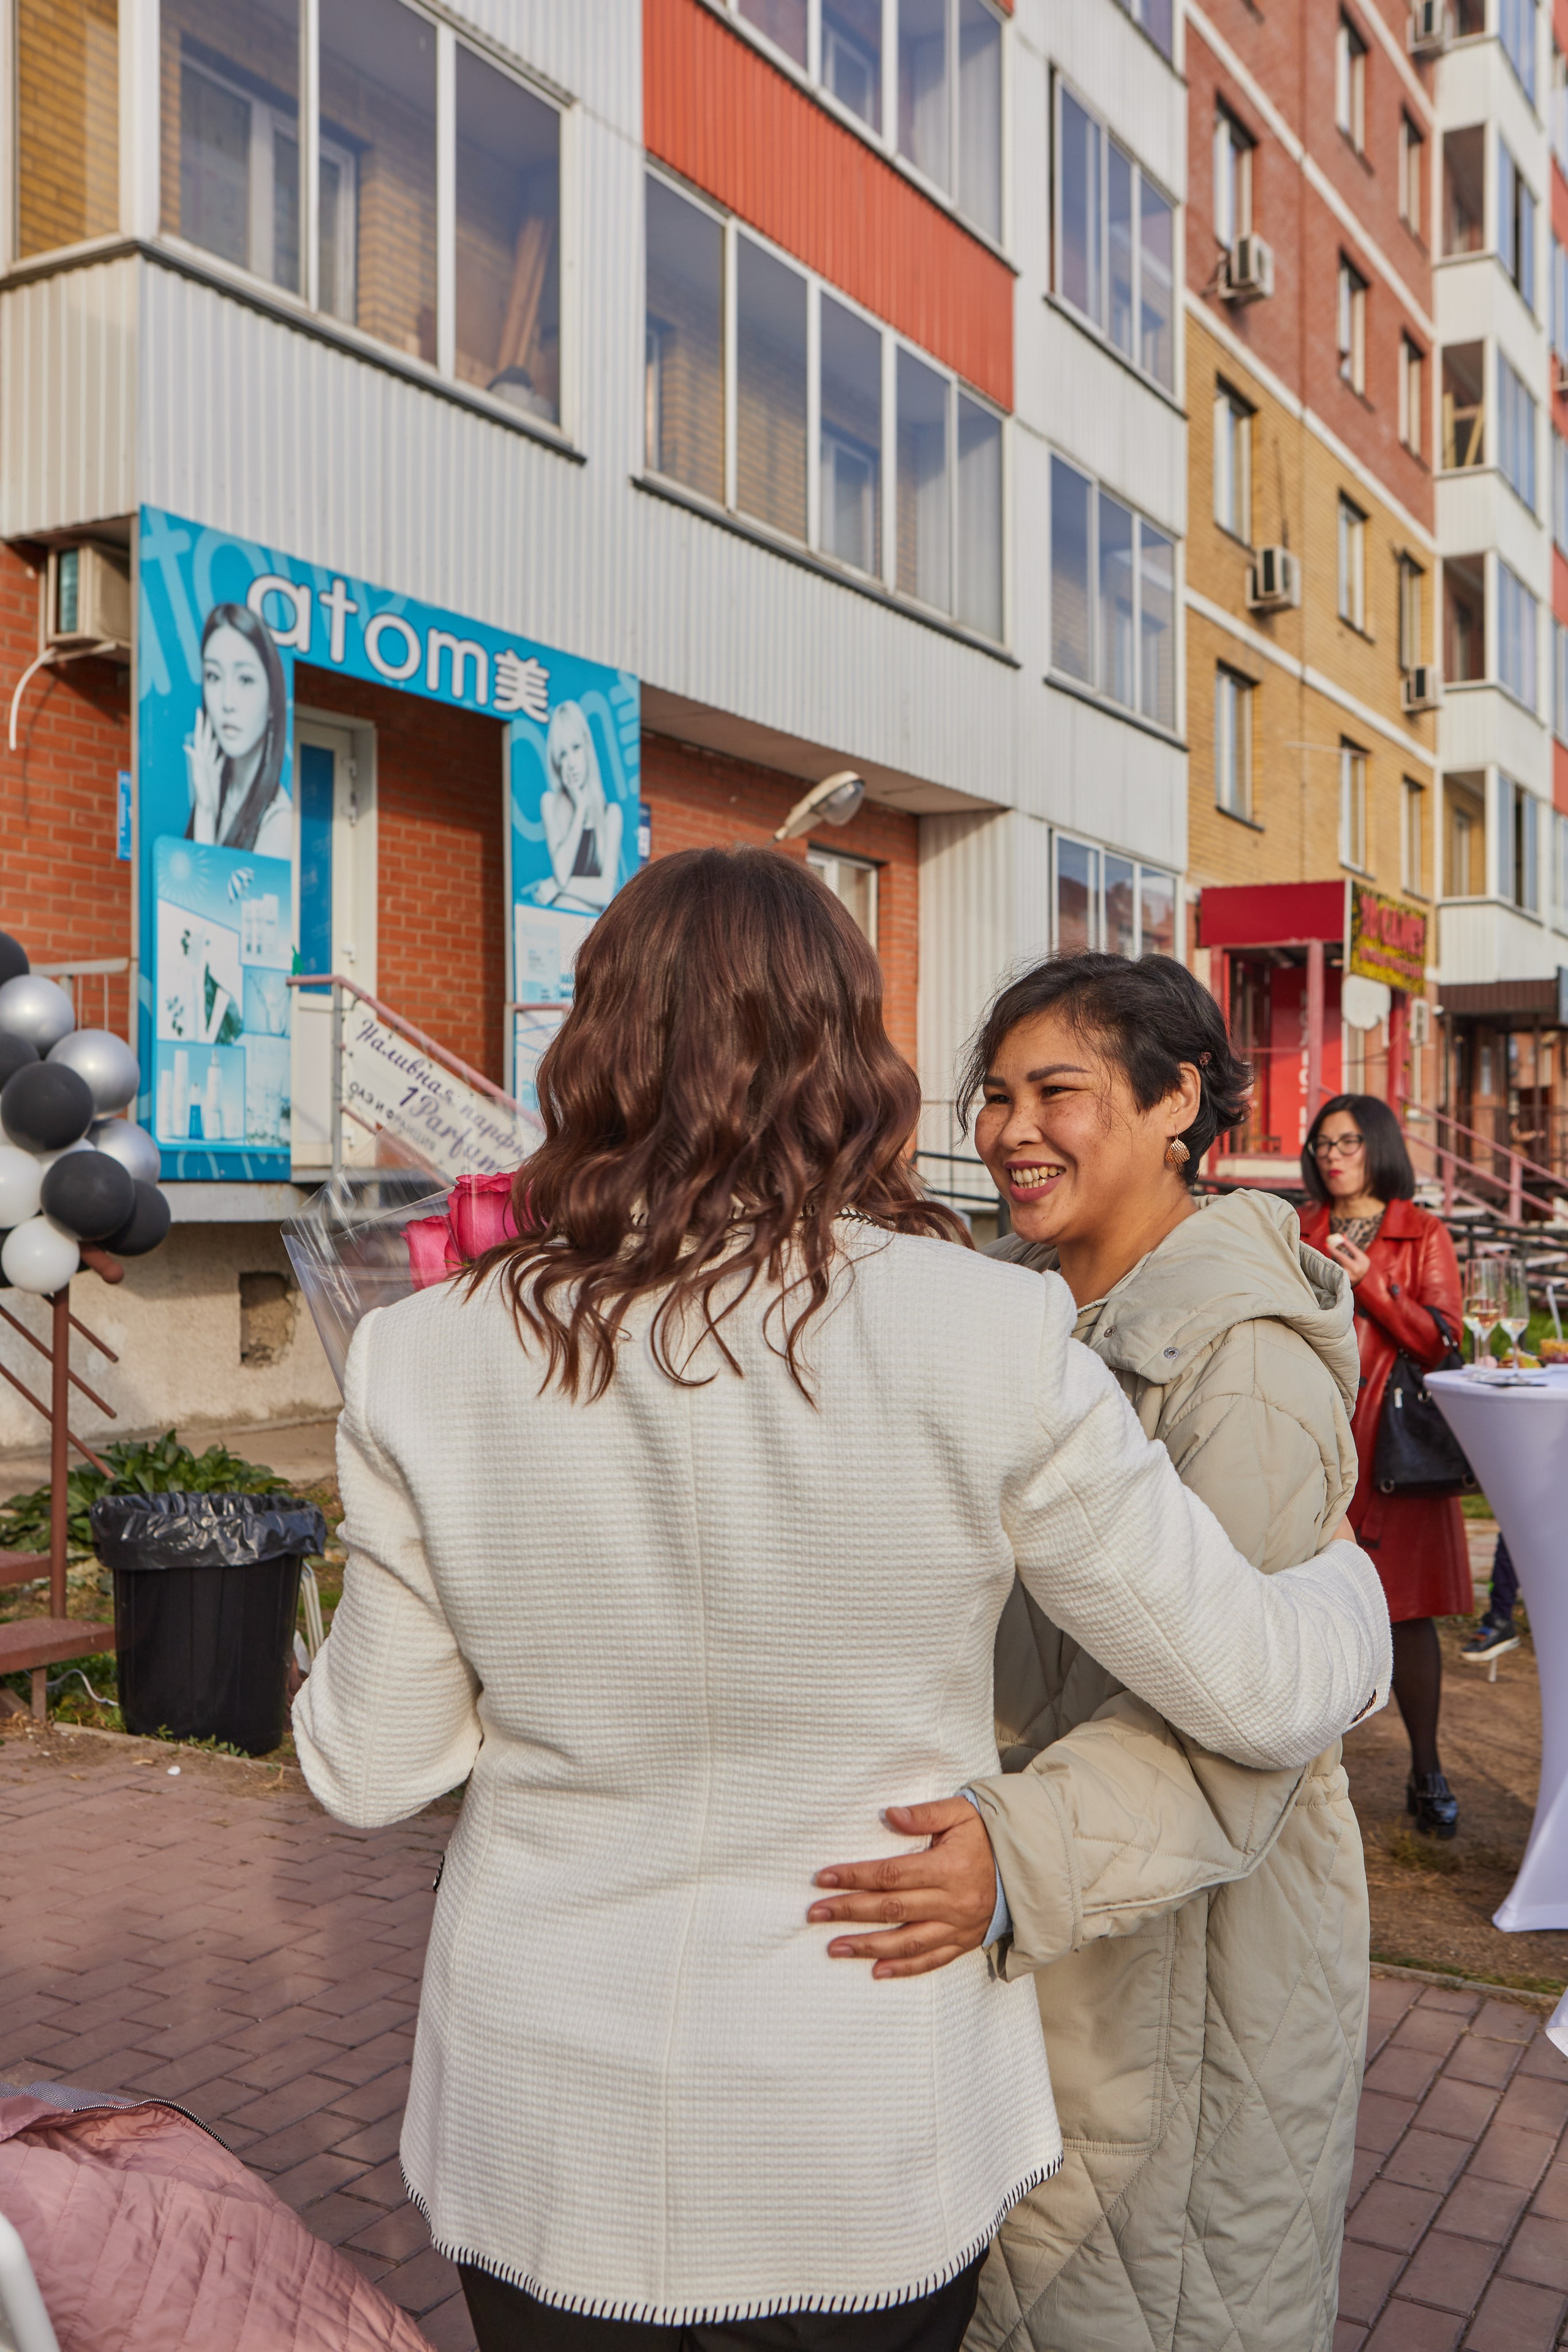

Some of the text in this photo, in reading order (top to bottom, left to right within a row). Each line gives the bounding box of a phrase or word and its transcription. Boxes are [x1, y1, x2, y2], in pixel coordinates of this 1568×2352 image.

[356, 1019, 454, 1106] Наливная
[349, 1081, 374, 1103] ОАЭ
[375, 1101, 384, 1112] И
